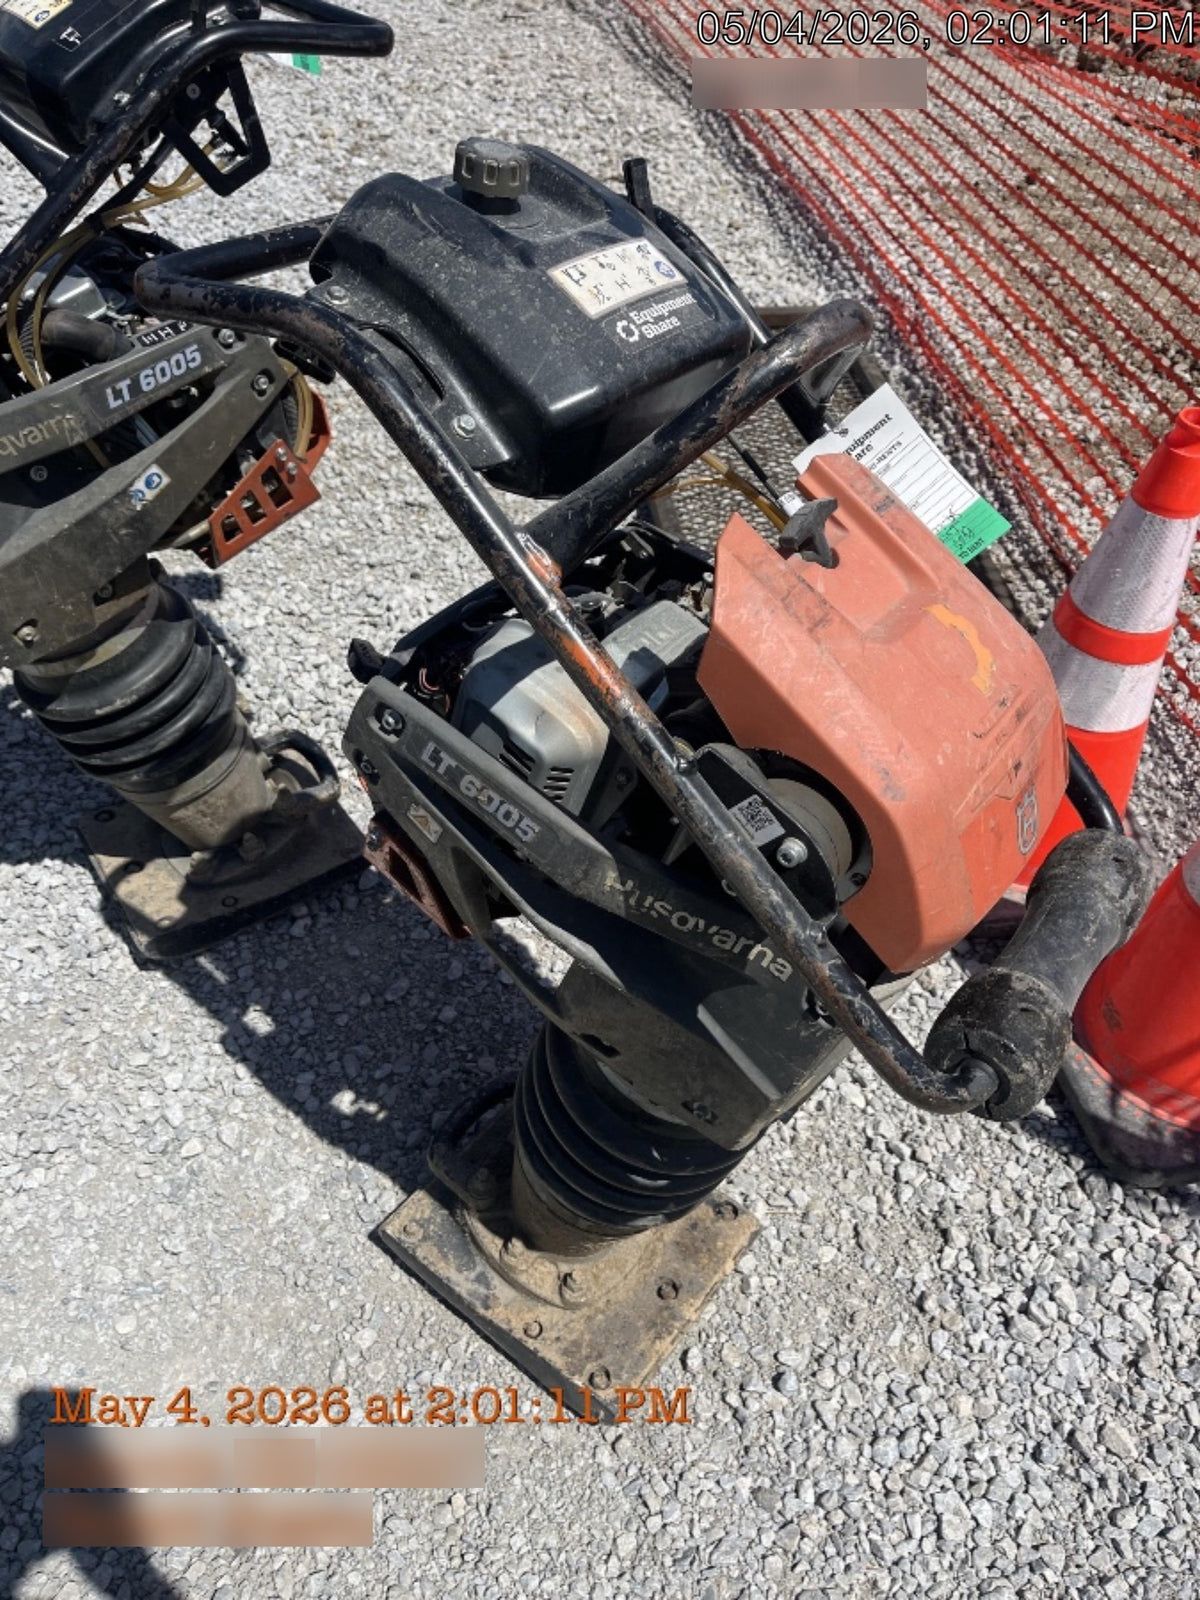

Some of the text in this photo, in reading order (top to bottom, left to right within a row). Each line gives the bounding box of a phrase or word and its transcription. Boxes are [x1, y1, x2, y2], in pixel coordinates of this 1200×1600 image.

[629, 292, 698, 324] Equipment
[641, 316, 681, 338] Share
[105, 344, 201, 409] LT 6005
[842, 413, 893, 456] quipment
[421, 741, 541, 841] LT 6005
